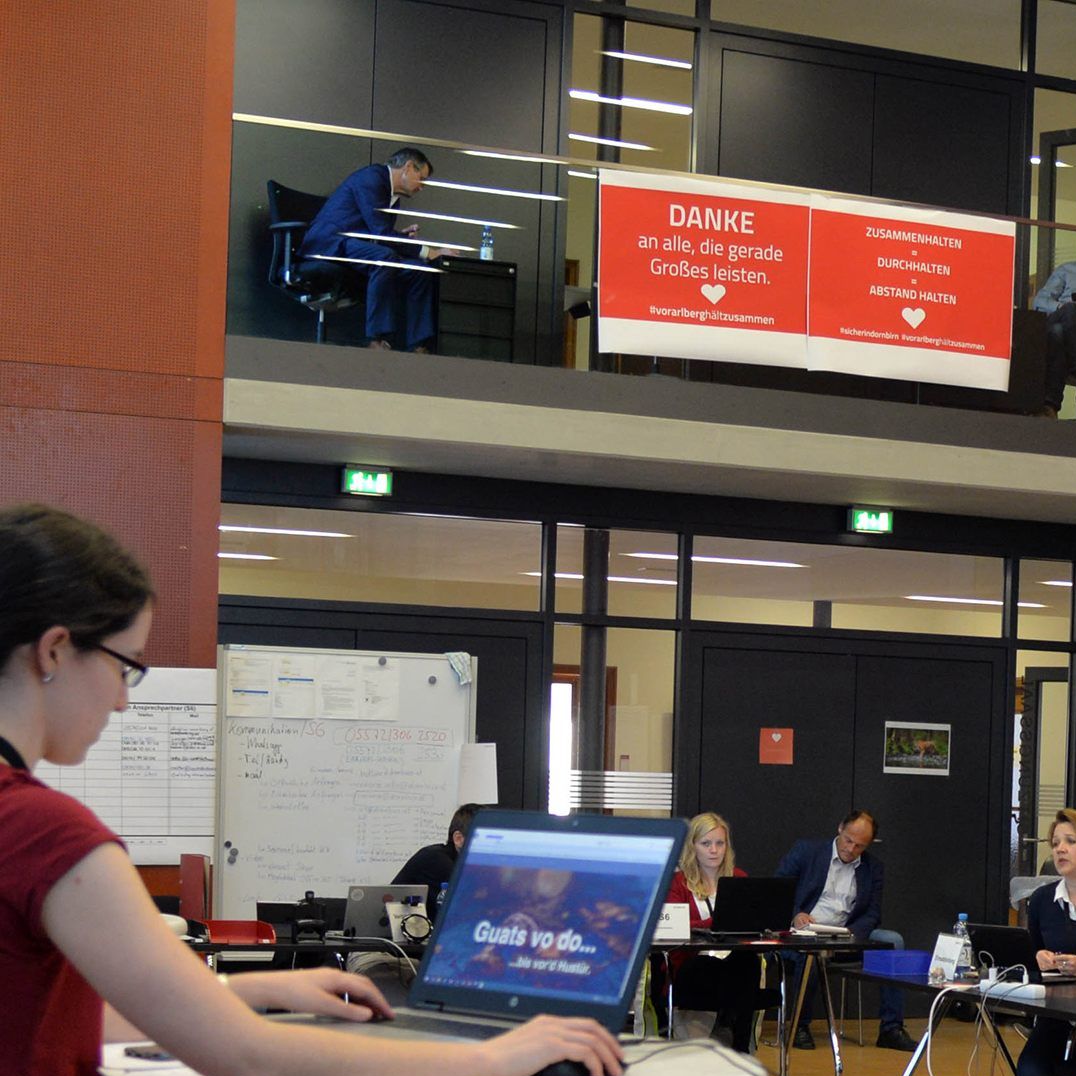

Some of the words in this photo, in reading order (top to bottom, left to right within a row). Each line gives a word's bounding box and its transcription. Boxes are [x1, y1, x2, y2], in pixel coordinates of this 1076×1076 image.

[669, 203, 755, 235] DANKE
[638, 235, 659, 250] an
[662, 235, 695, 256] alle,
[700, 238, 724, 256] die
[728, 244, 783, 262] gerade
[866, 226, 962, 249] ZUSAMMENHALTEN
[650, 258, 709, 280] Großes
[713, 263, 771, 285] leisten.
[877, 257, 950, 276] DURCHHALTEN
[869, 285, 917, 300] ABSTAND
[919, 289, 956, 305] HALTEN
[649, 305, 775, 325] #vorarlberghältzusammen
[839, 327, 900, 340] #sicherindornbirn
[473, 920, 528, 947] Guats
[530, 930, 554, 950] vo
[557, 928, 597, 953] do...
